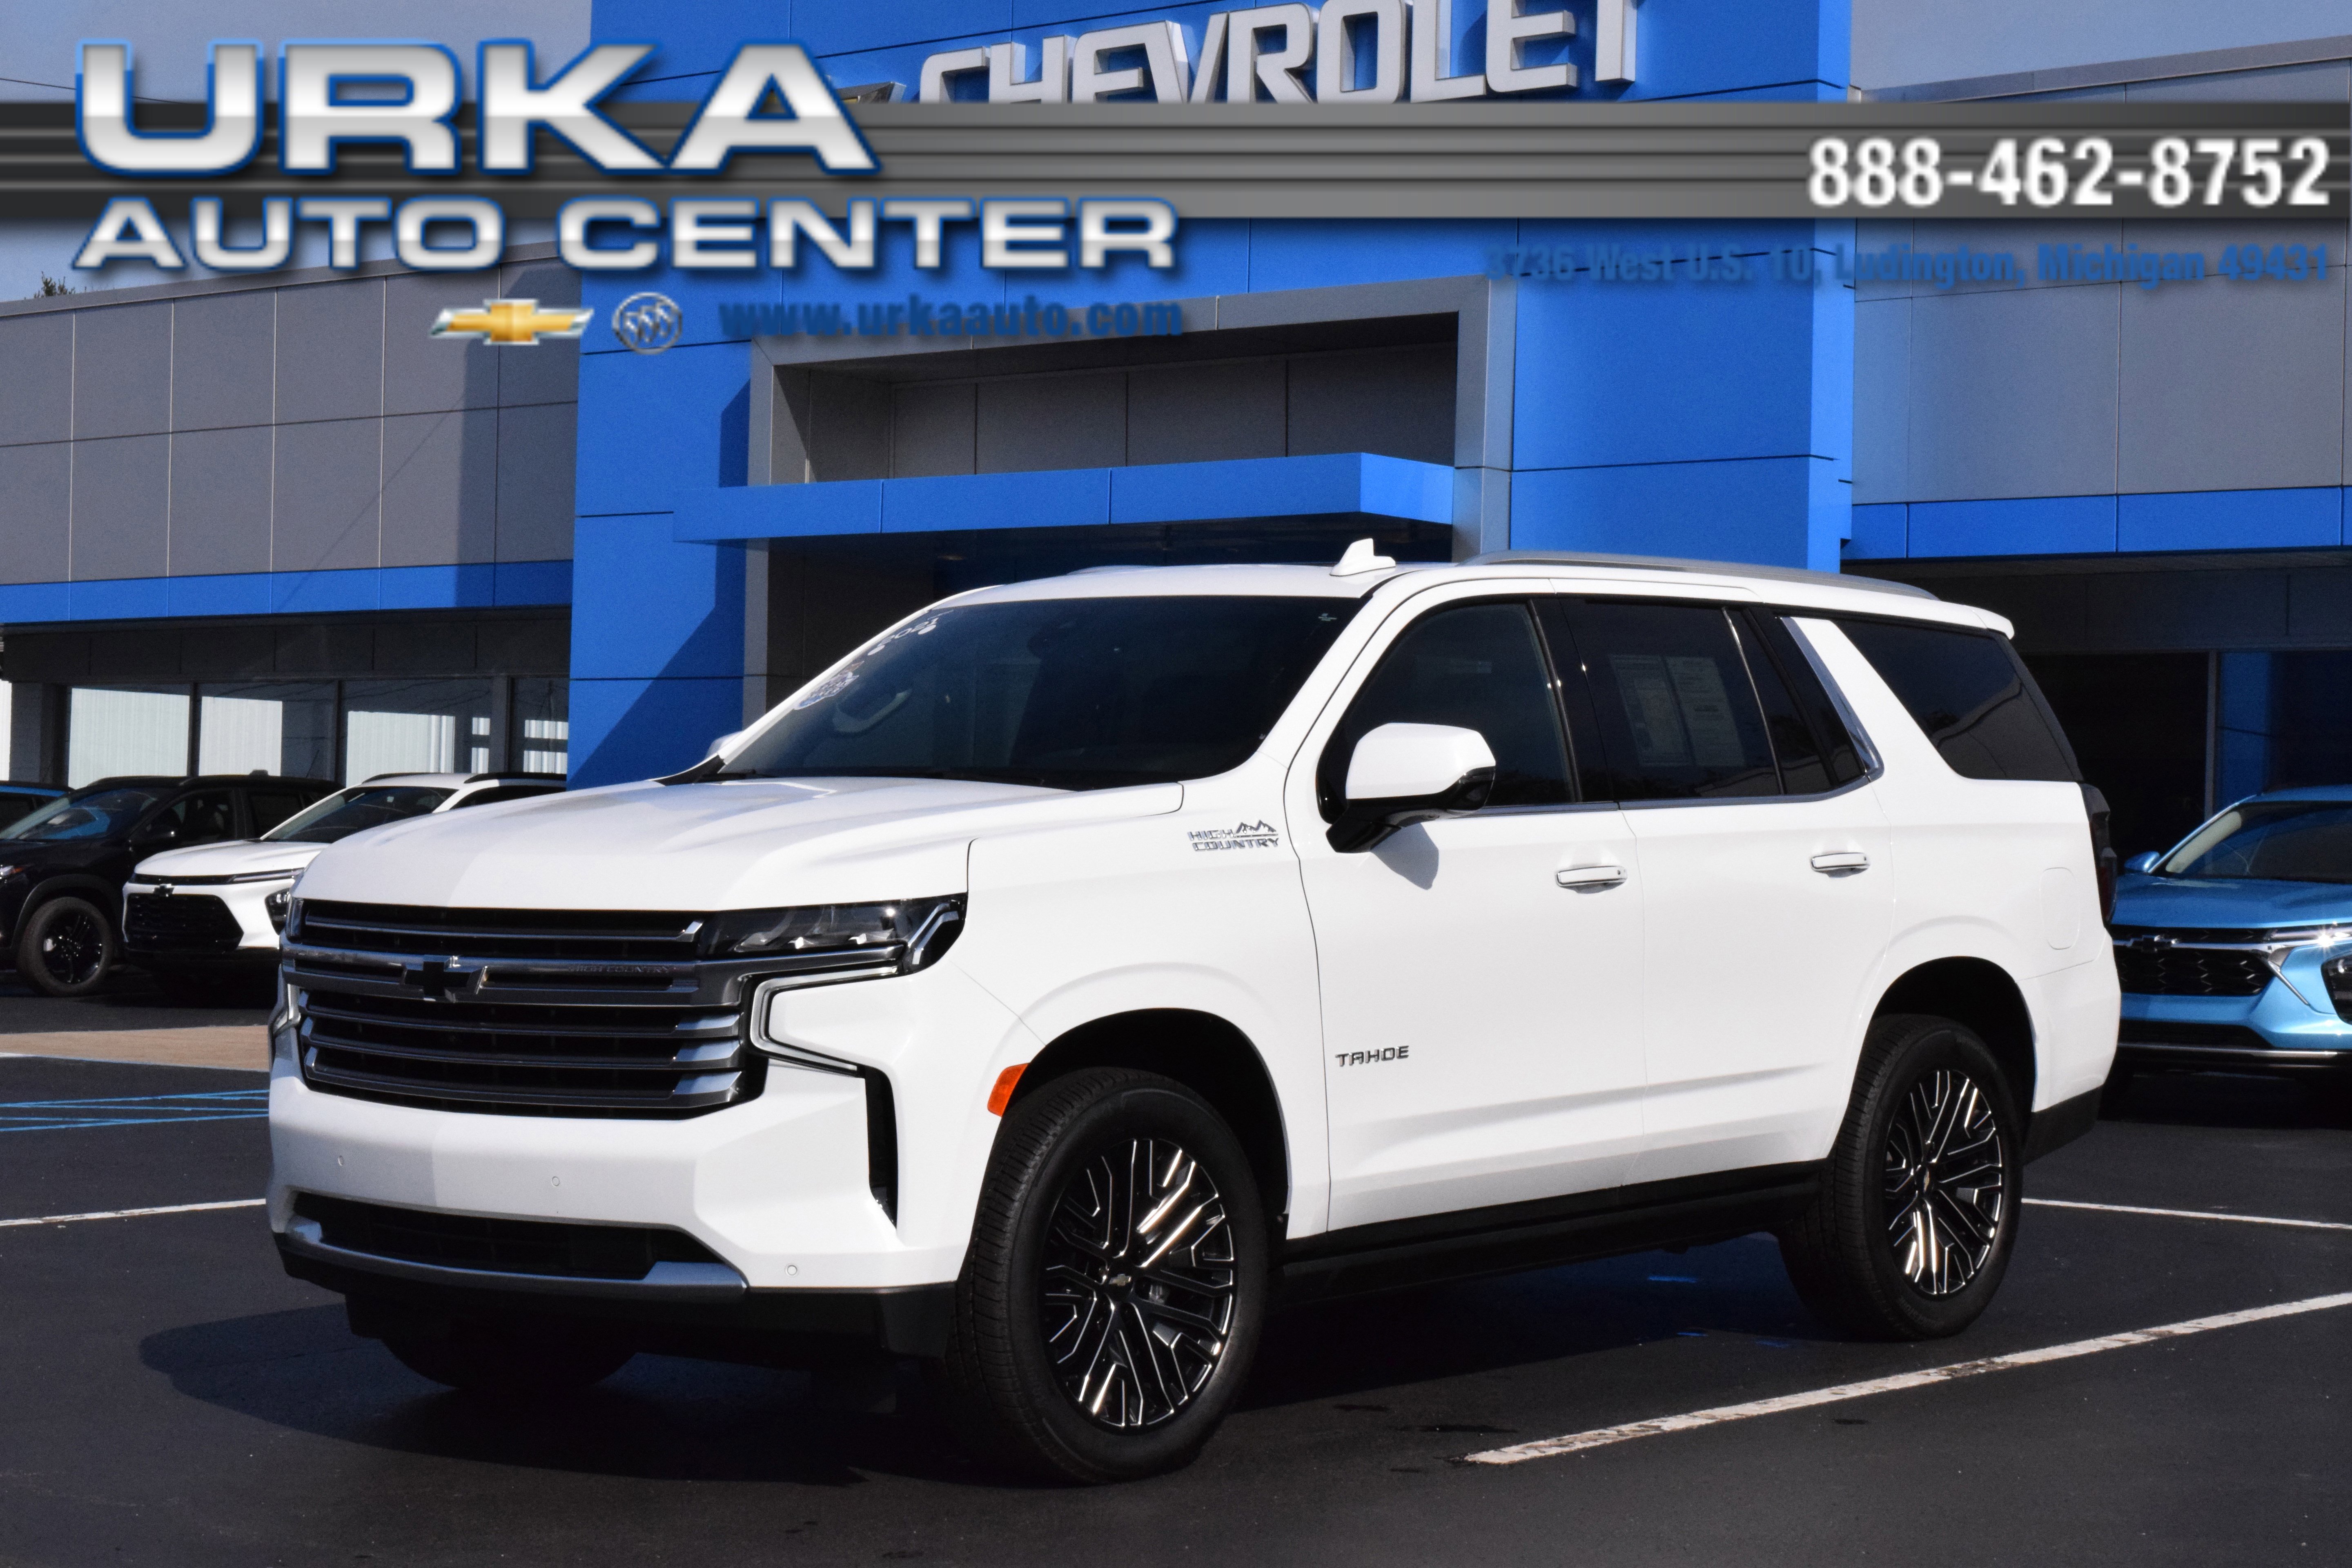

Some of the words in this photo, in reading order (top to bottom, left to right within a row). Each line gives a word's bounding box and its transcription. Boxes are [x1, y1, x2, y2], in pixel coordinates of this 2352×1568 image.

[1187, 829, 1233, 840] HIGH
[1192, 837, 1278, 851] COUNTRY
[1335, 1045, 1409, 1067] TAHOE
